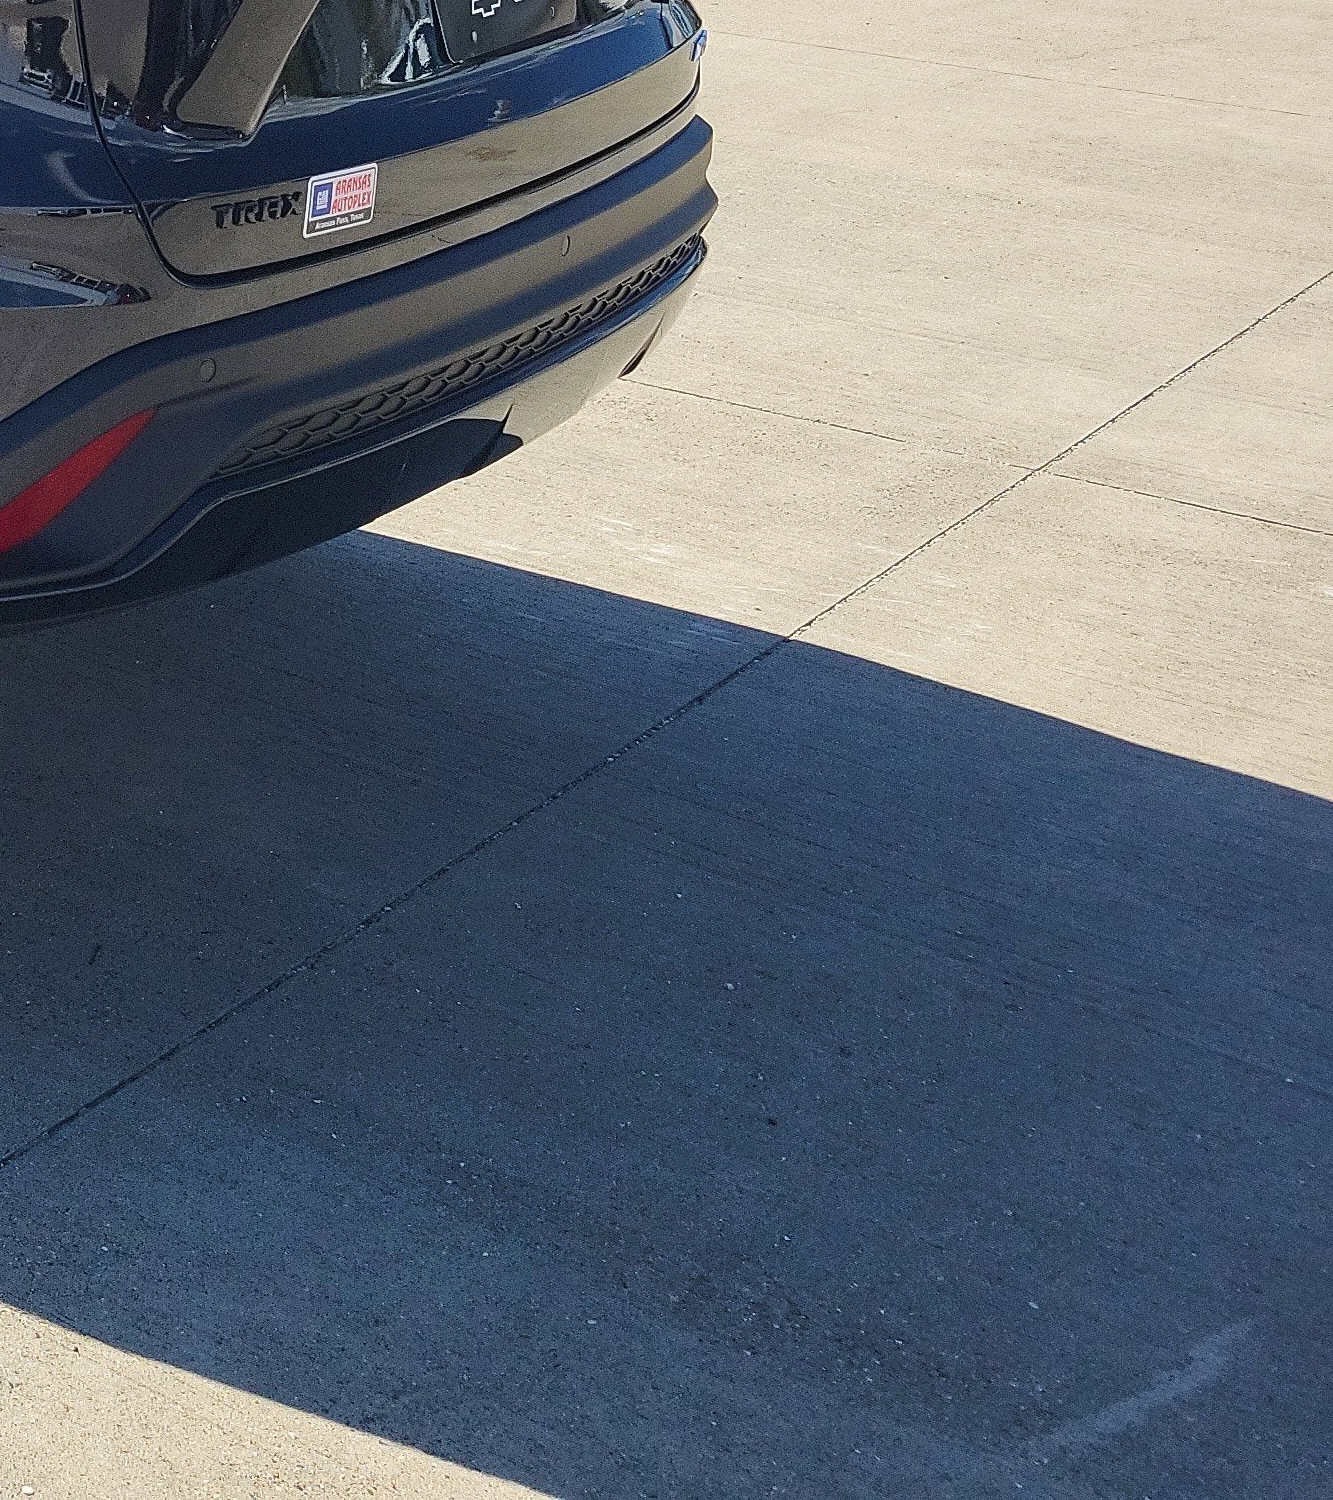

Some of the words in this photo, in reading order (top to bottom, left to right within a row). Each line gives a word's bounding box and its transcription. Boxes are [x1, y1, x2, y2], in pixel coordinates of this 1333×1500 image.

[335, 173, 372, 197] ARANSAS
[210, 191, 303, 230] TRAX
[331, 190, 372, 215] AUTOPLEX
